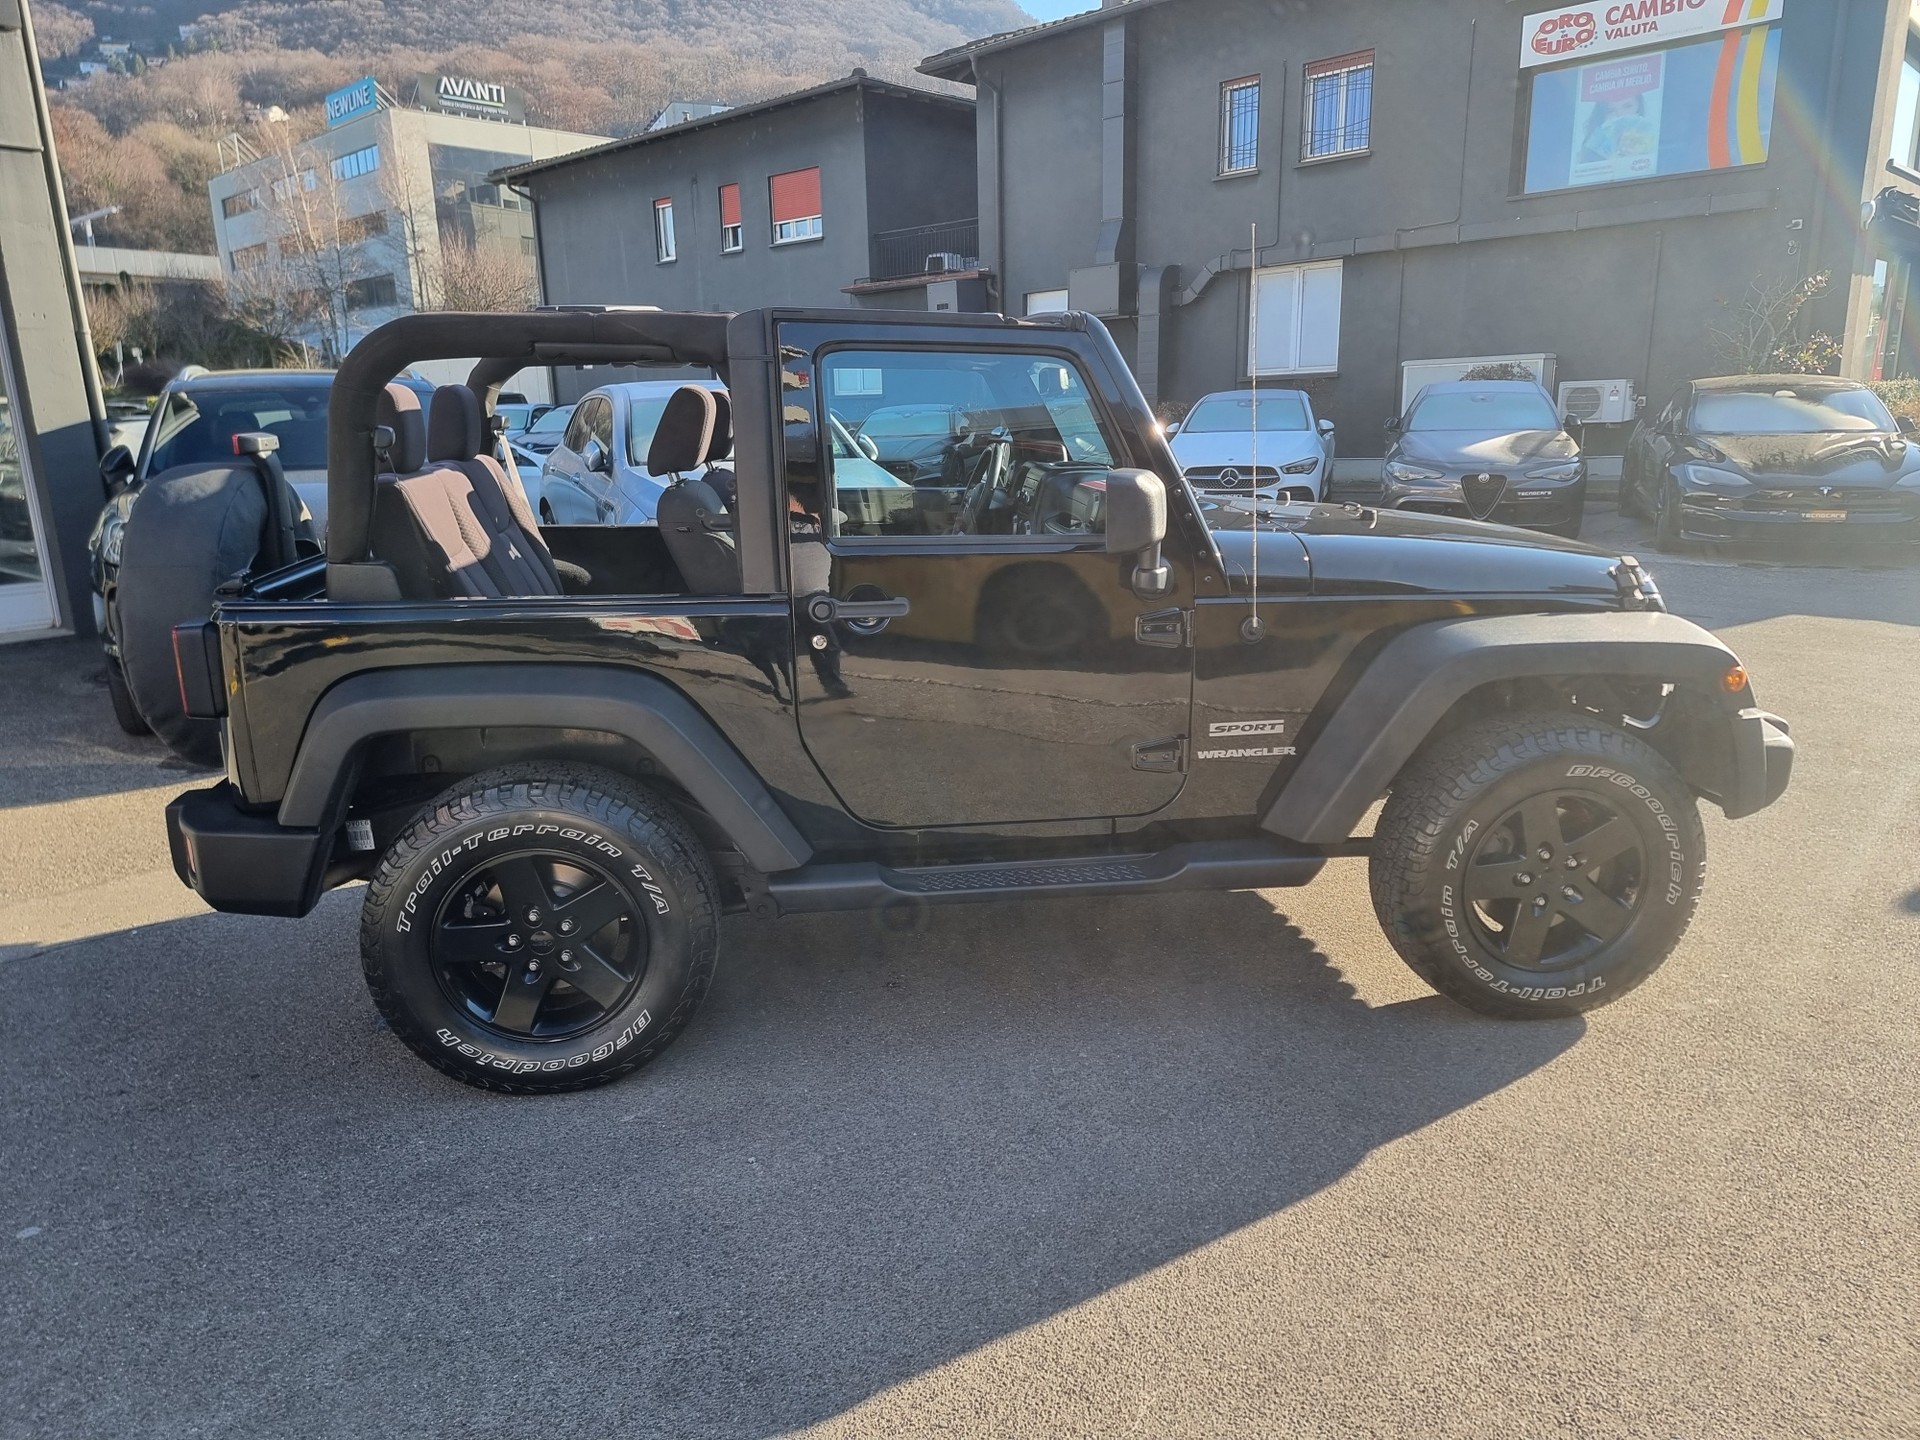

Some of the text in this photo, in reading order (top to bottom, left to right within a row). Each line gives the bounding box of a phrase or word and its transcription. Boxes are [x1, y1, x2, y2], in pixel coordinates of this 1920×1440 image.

[1539, 12, 1594, 35] ORO
[1604, 20, 1659, 40] VALUTA
[1534, 28, 1594, 54] EURO
[327, 85, 370, 121] NEWLINE
[440, 75, 506, 104] AVANTI
[1214, 723, 1278, 733] SPORT
[1197, 746, 1296, 759] WRANGLER
[1446, 819, 1479, 870] T/A
[1566, 764, 1684, 906] BFGoodrich
[630, 863, 670, 915] T/A
[436, 1009, 652, 1075] BFGoodrich
